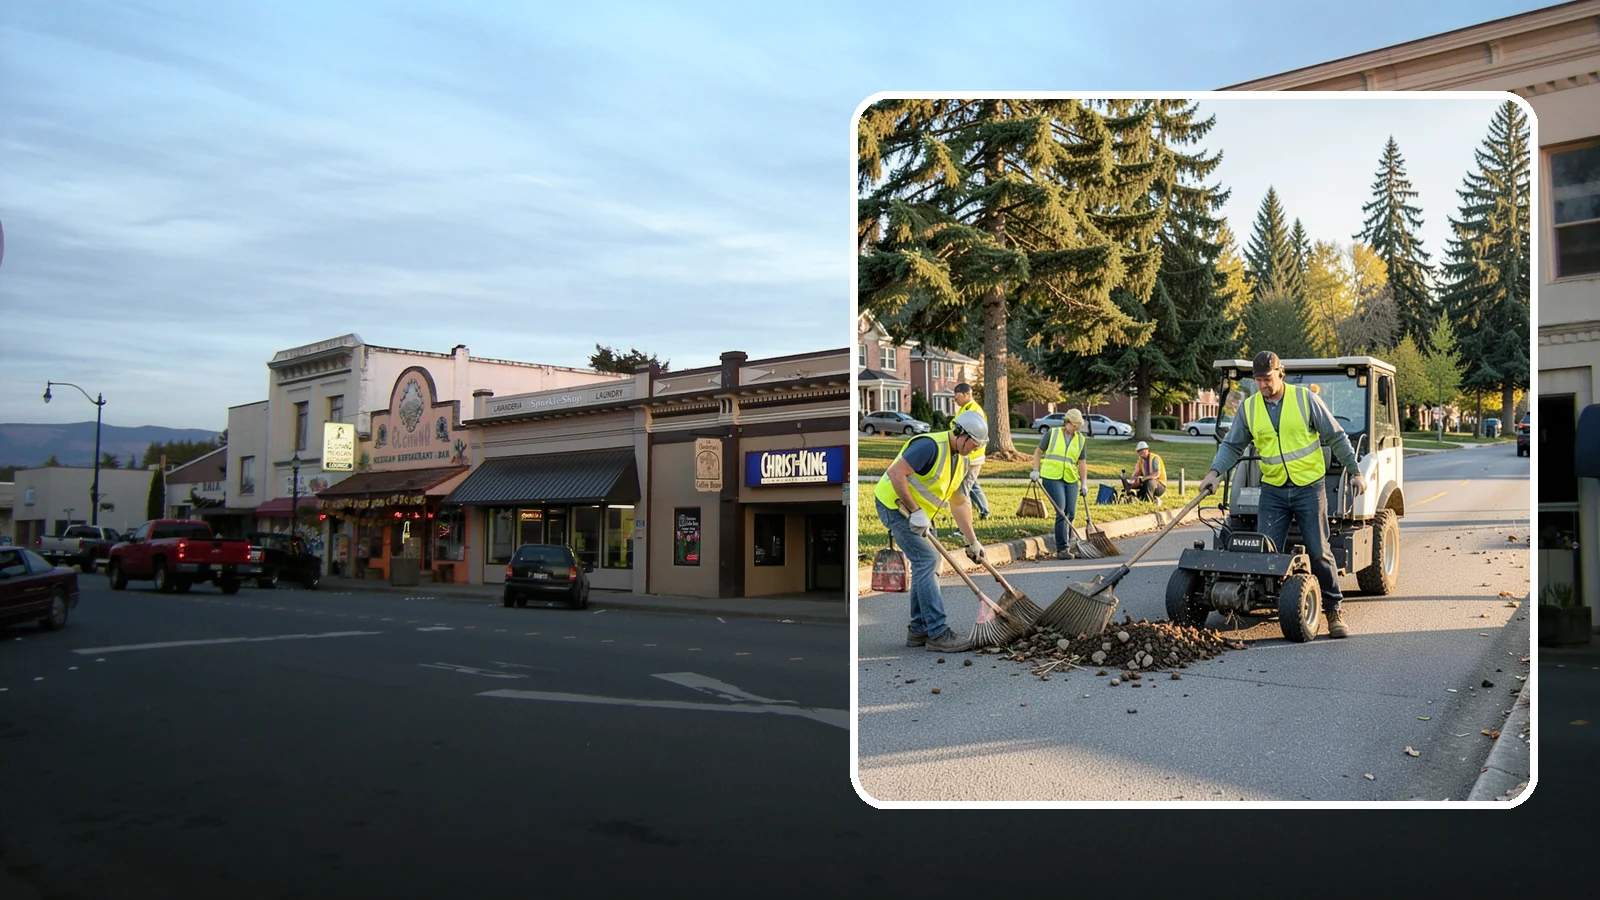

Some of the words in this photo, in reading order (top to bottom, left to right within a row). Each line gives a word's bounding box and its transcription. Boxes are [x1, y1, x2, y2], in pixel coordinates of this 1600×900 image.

[595, 388, 624, 400] LAUNDRY
[493, 402, 523, 412] LAVANDERIA
[373, 454, 397, 464] MEXICAN
[397, 451, 434, 462] RESTAURANT
[437, 450, 450, 459] BAR
[760, 452, 798, 478] CHRIST
[799, 450, 827, 476] KING
